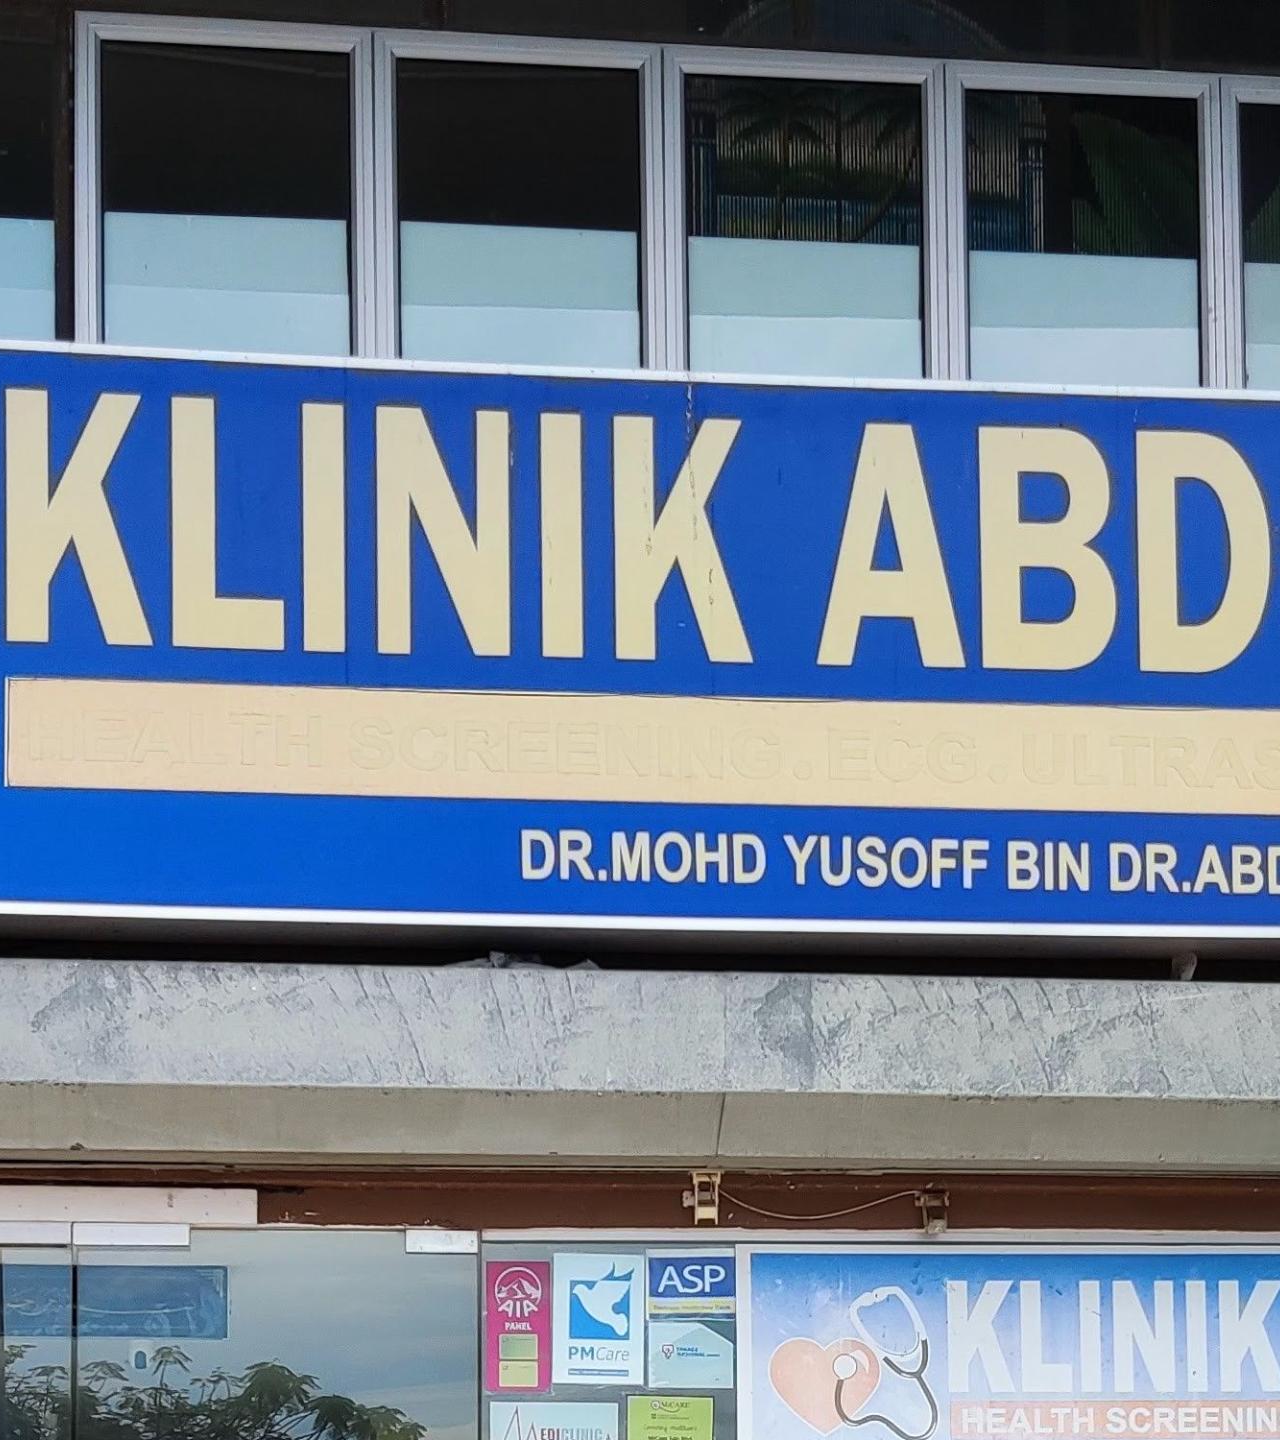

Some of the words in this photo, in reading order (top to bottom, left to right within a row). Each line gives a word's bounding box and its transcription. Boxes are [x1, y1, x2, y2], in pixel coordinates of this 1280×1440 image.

[6, 387, 753, 664] KLINIK
[27, 708, 324, 769] HEALTH
[521, 829, 766, 885] DR.MOHD
[784, 834, 990, 889] YUSOFF
[1006, 840, 1090, 892] BIN
[658, 1264, 726, 1294] ASP
[498, 1300, 538, 1318] AIA
[505, 1322, 532, 1331] PANEL
[569, 1346, 630, 1361] PMCare
[961, 1408, 1096, 1434] HEALTH
